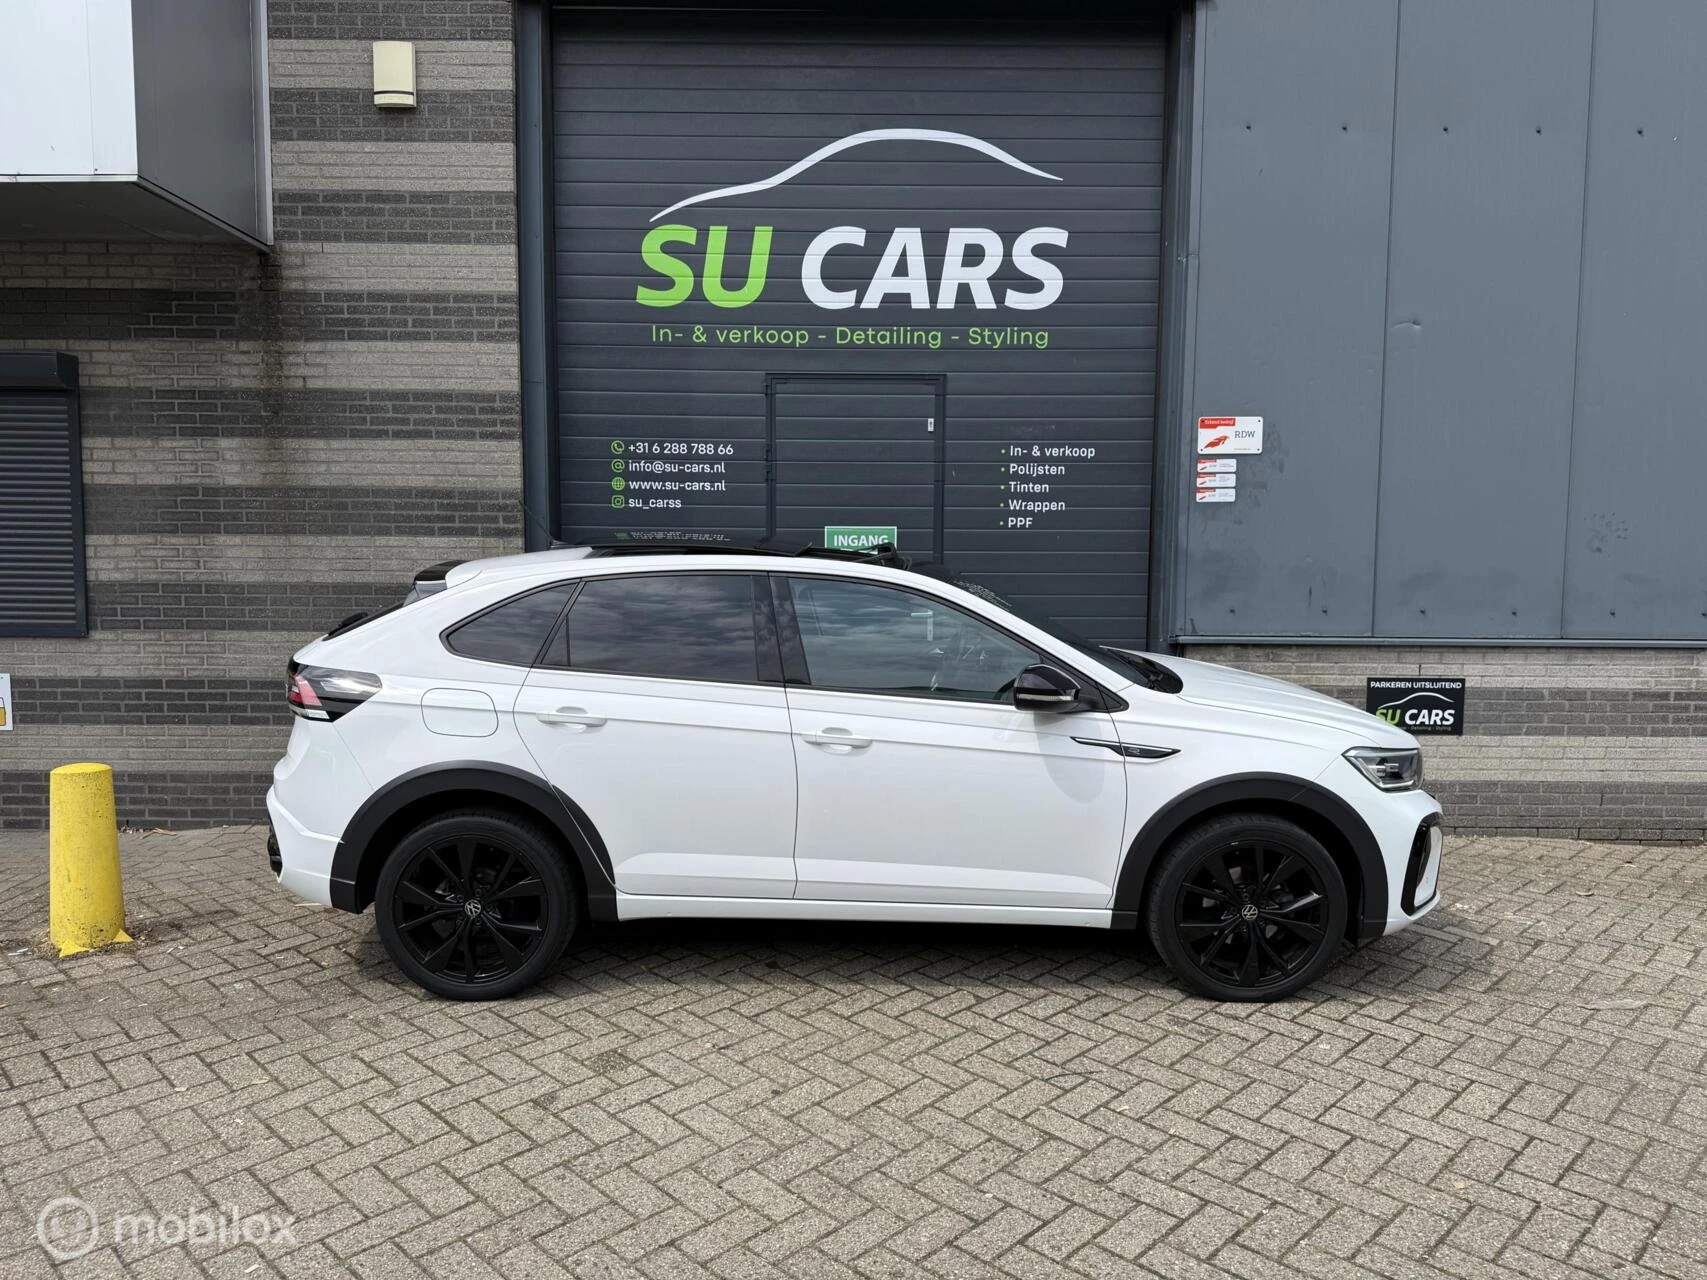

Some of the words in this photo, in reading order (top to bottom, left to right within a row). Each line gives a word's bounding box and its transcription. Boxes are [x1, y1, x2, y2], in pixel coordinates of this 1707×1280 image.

[636, 224, 773, 308] SU
[801, 226, 1069, 310] CARS
[652, 325, 684, 342] In-
[692, 325, 708, 343] &
[716, 325, 809, 346] verkoop
[836, 327, 942, 348] Detailing
[968, 327, 1049, 349] Styling
[1234, 430, 1256, 439] RDW
[628, 442, 649, 454] +31
[652, 442, 661, 454] 6
[663, 443, 688, 454] 288
[691, 443, 715, 455] 788
[717, 444, 734, 455] 66
[1010, 445, 1028, 456] In-
[1032, 445, 1041, 457] &
[1044, 445, 1096, 459] verkoop
[628, 460, 726, 473] info@su-cars.nl
[1009, 463, 1065, 477] Polijsten
[628, 480, 726, 491] www.su-cars.nl
[1009, 481, 1050, 493] Tinten
[628, 498, 682, 509] su_carss
[1008, 499, 1066, 512] Wrappen
[1008, 517, 1033, 528] PPF
[833, 534, 889, 547] INGANG
[1370, 681, 1412, 689] PARKEREN
[1413, 681, 1462, 689] UITSLUITEND
[1404, 708, 1456, 725] CARS
